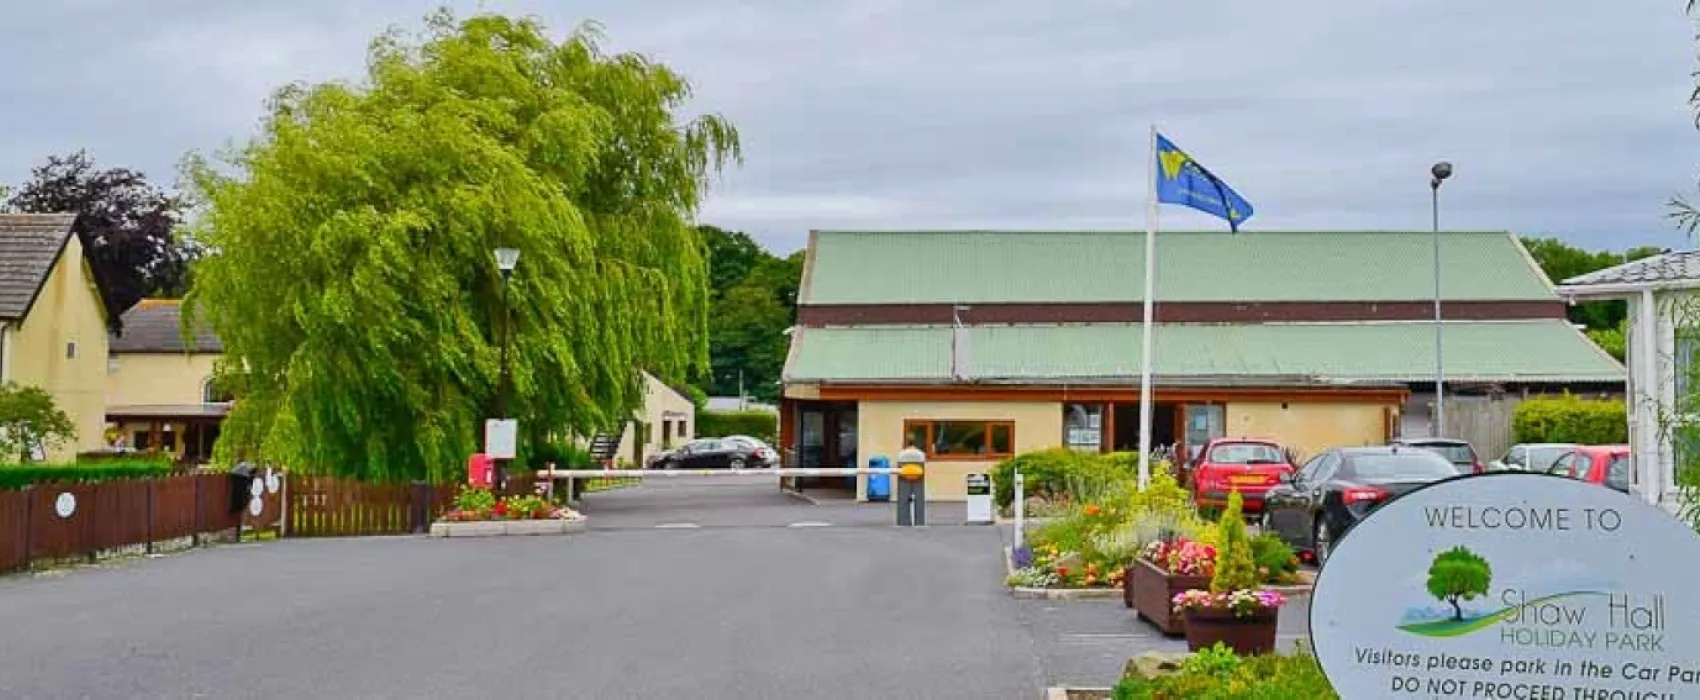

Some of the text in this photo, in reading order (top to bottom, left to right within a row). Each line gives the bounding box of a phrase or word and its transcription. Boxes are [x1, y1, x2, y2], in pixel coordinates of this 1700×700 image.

[1424, 506, 1622, 531] WELCOME TO
[1501, 588, 1665, 631] Shaw Hall
[1500, 627, 1665, 651] HOLIDAY PARK
[1355, 647, 1420, 667] Visitors
[1427, 652, 1493, 672] please
[1500, 658, 1547, 676] park
[1554, 659, 1573, 676] in
[1580, 660, 1613, 679] the
[1621, 662, 1661, 682] Car
[1391, 676, 1420, 693] DO
[1427, 678, 1467, 697] NOT
[1473, 681, 1566, 700] PROCEED
